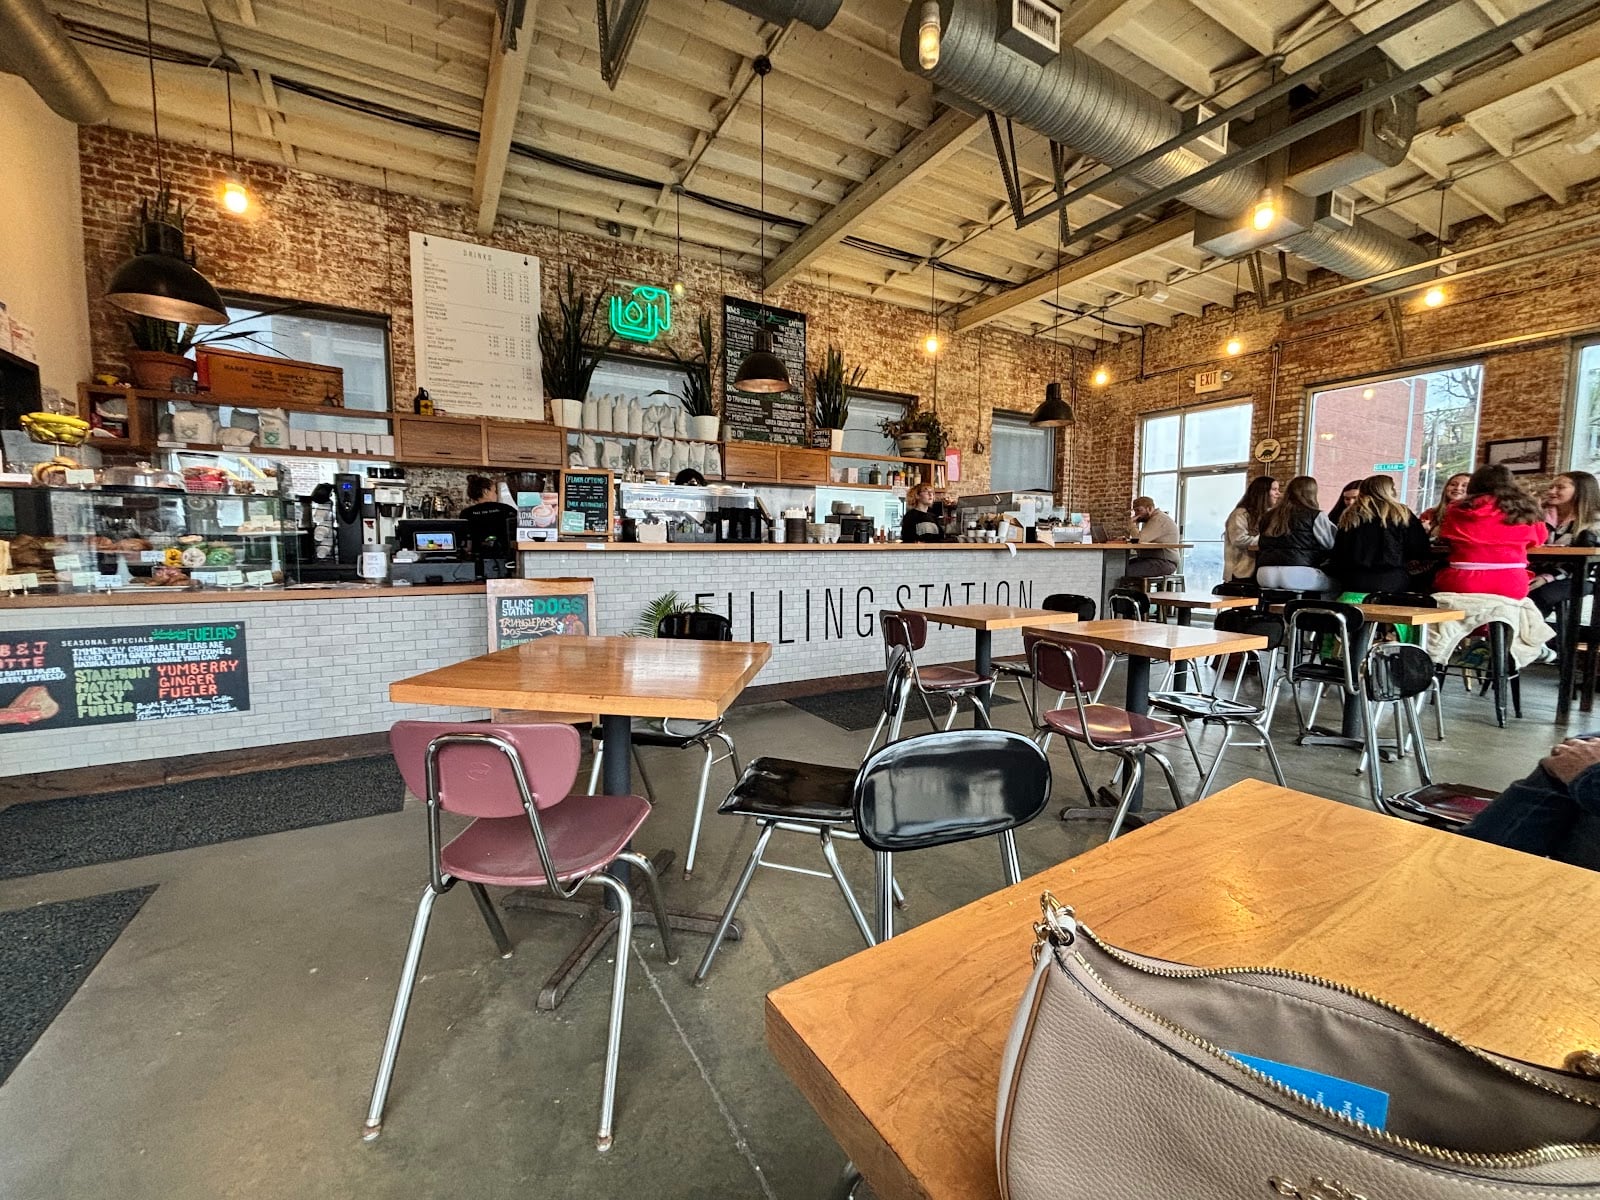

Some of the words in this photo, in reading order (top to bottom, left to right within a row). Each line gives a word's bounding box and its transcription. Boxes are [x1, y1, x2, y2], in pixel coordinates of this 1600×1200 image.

[463, 249, 493, 261] DRINKS
[1200, 371, 1218, 387] EXIT
[502, 599, 534, 609] FILLING
[534, 598, 585, 615] DOGS
[502, 607, 534, 616] STATION
[187, 626, 237, 642] FUELERS
[502, 627, 522, 638] DOG
[61, 639, 107, 647] SEASONAL
[72, 646, 125, 656] IMMENSELY
[176, 641, 208, 651] FUELERS
[209, 641, 224, 649] ARE
[73, 654, 104, 662] PACKED
[106, 652, 127, 661] WITH
[157, 650, 186, 658] COFFEE
[74, 660, 110, 668] NATURAL
[152, 656, 183, 664] CHARGE
[75, 666, 151, 683] STARFRUIT
[157, 659, 239, 677] YUMBERRY
[76, 680, 134, 694] MATCHA
[160, 673, 216, 688] GINGER
[159, 684, 218, 699] FUELER
[78, 701, 135, 719] FUELER
